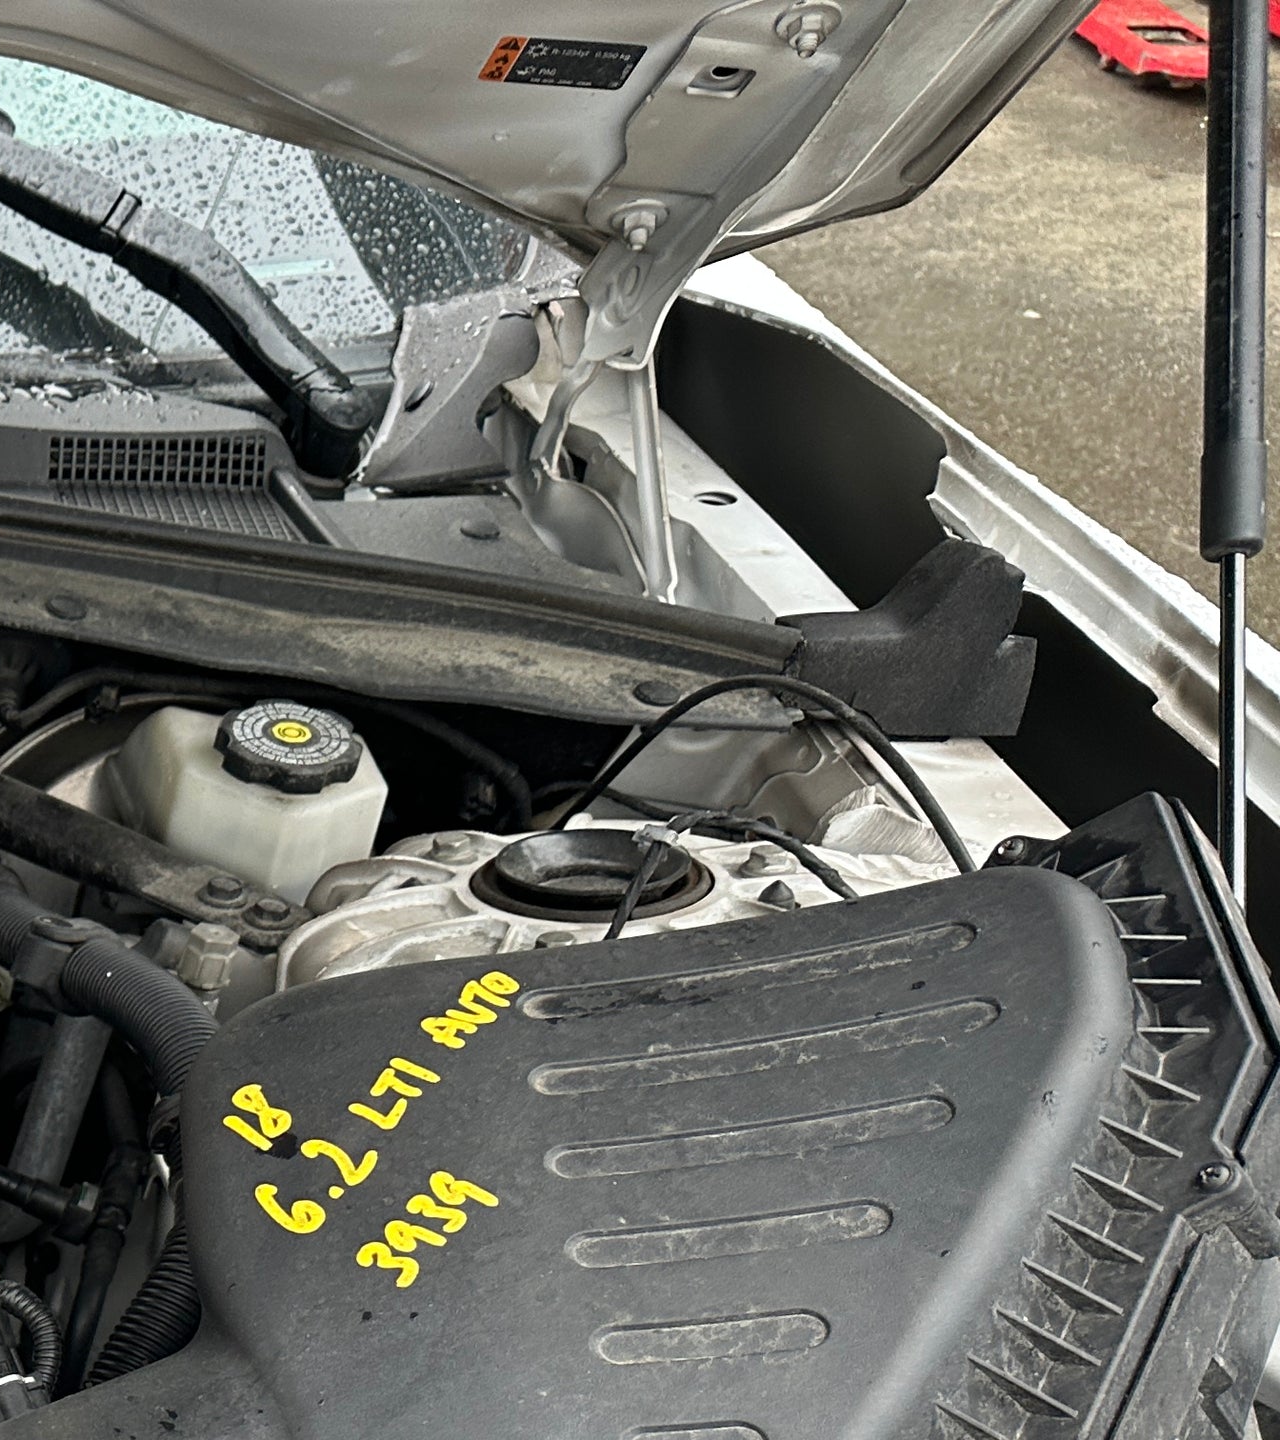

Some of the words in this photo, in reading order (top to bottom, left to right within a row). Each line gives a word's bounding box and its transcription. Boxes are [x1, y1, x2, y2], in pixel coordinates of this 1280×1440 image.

[223, 1084, 292, 1151] 18
[255, 1139, 378, 1234] 6.2
[420, 971, 521, 1049] AUTO
[356, 1171, 500, 1288] 3939
